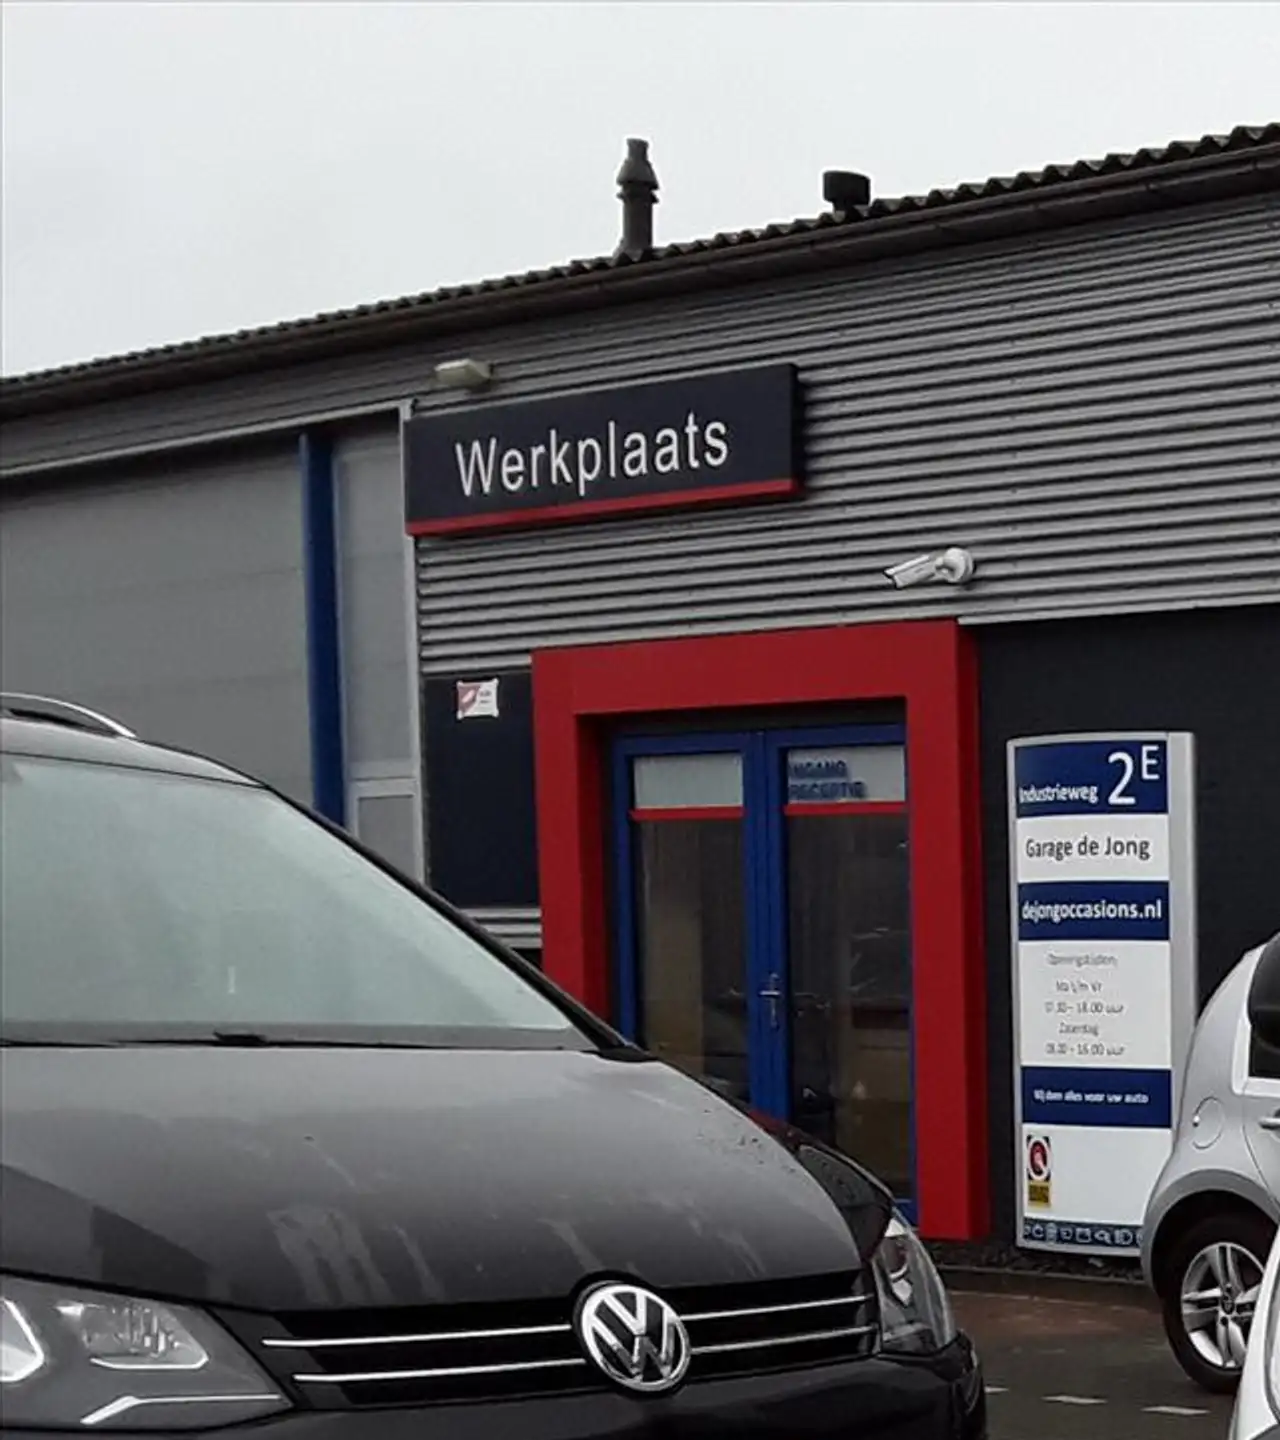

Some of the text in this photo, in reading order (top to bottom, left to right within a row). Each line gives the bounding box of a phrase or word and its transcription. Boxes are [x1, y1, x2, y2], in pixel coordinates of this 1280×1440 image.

[455, 412, 730, 497] Werkplaats
[1019, 783, 1098, 805] Industrieweg
[1026, 835, 1150, 862] Garage de Jong
[1022, 899, 1162, 923] dejongoccasions.nl
